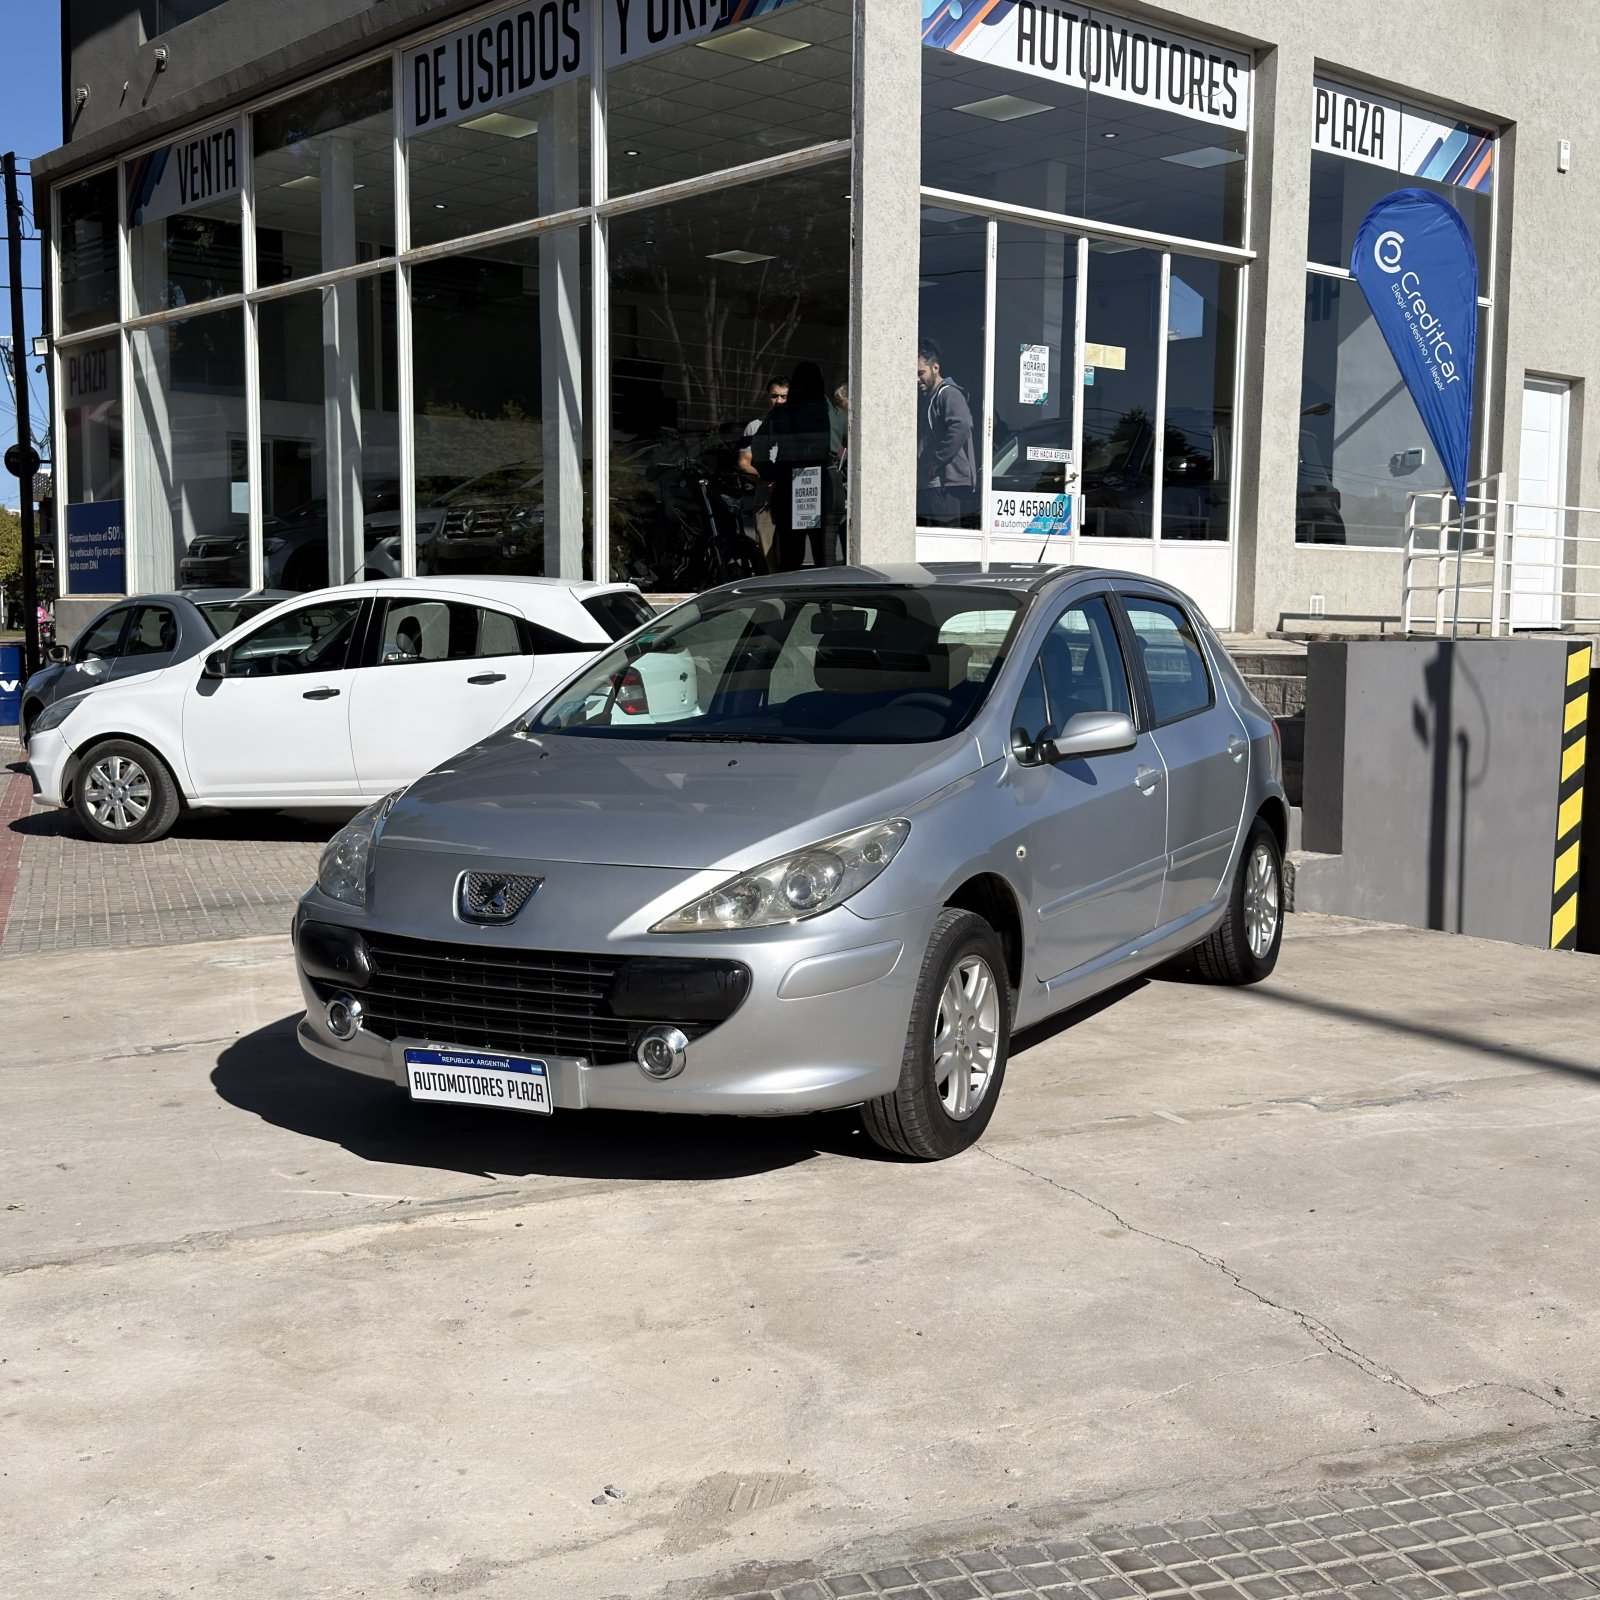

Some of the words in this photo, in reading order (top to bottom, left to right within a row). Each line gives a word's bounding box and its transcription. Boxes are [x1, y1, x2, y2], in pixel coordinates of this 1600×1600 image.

[414, 45, 447, 127] DE
[456, 0, 580, 111] USADOS
[616, 0, 631, 55] Y
[1017, 0, 1238, 119] AUTOMOTORES
[1315, 88, 1385, 160] PLAZA
[176, 128, 237, 205] VENTA
[1391, 282, 1407, 310] Elegir
[1404, 311, 1413, 321] el
[1409, 322, 1429, 356] destino
[1430, 365, 1446, 392] llegar
[1401, 271, 1460, 384] CreditCar
[69, 348, 108, 397] PLAZA
[1022, 361, 1046, 372] HORARIO
[1029, 449, 1039, 458] TIRE
[1040, 450, 1053, 459] HACIA
[1054, 451, 1071, 460] AFUERA
[795, 487, 818, 498] HORARIO
[996, 498, 1016, 517] 249
[1019, 500, 1064, 518] 4658008
[89, 532, 102, 542] hasta
[102, 532, 108, 541] el
[69, 549, 75, 558] tu
[94, 546, 102, 558] fijo
[103, 548, 109, 556] en
[80, 562, 89, 570] con
[89, 559, 99, 570] DNI
[441, 1056, 475, 1065] REPUBLICA
[476, 1059, 510, 1068] ARGENTINA
[413, 1071, 504, 1098] AUTOMOTORES
[507, 1080, 545, 1103] PLAZA
